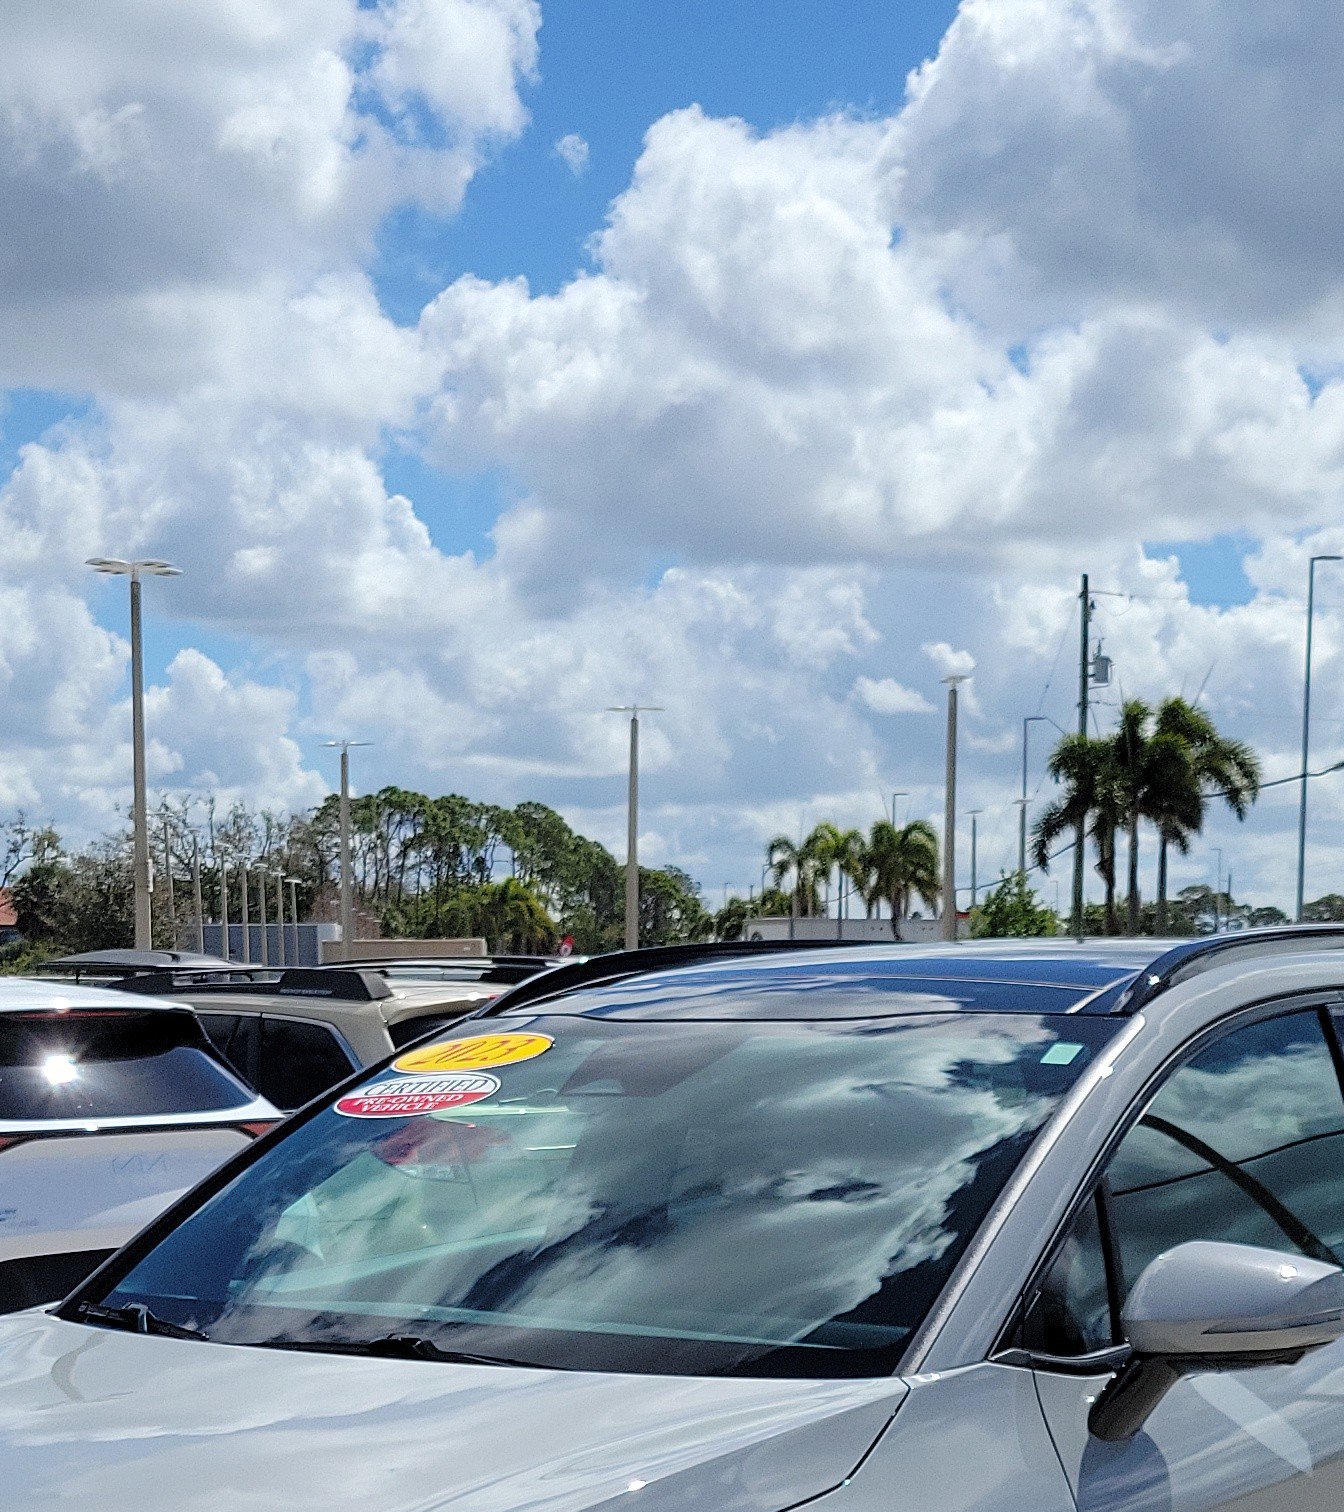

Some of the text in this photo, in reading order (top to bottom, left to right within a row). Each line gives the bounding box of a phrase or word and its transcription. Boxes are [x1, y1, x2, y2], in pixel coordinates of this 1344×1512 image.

[406, 1038, 537, 1067] 2023
[364, 1079, 488, 1096] CERTIFIED
[353, 1094, 464, 1106] PRE-OWNED
[360, 1102, 439, 1113] VEHICLE
